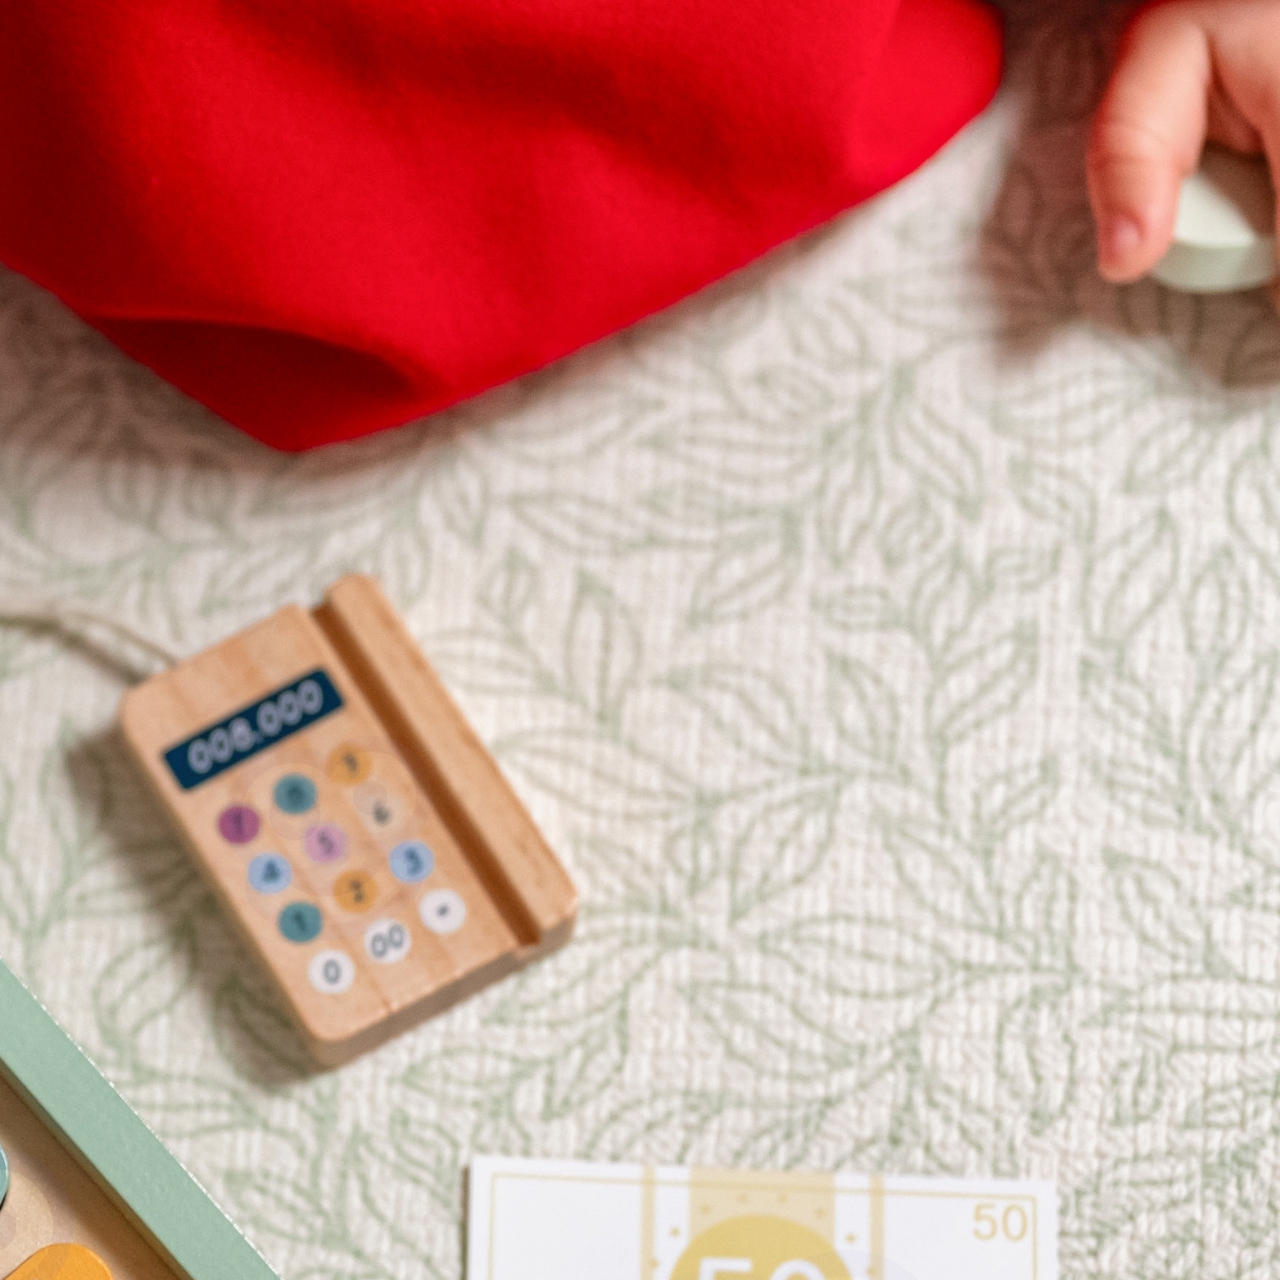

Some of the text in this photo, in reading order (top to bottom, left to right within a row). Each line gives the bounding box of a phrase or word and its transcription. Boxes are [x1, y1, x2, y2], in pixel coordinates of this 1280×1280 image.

[186, 678, 324, 775] 008.000
[322, 922, 406, 986] 0 00
[971, 1202, 1030, 1243] 50
